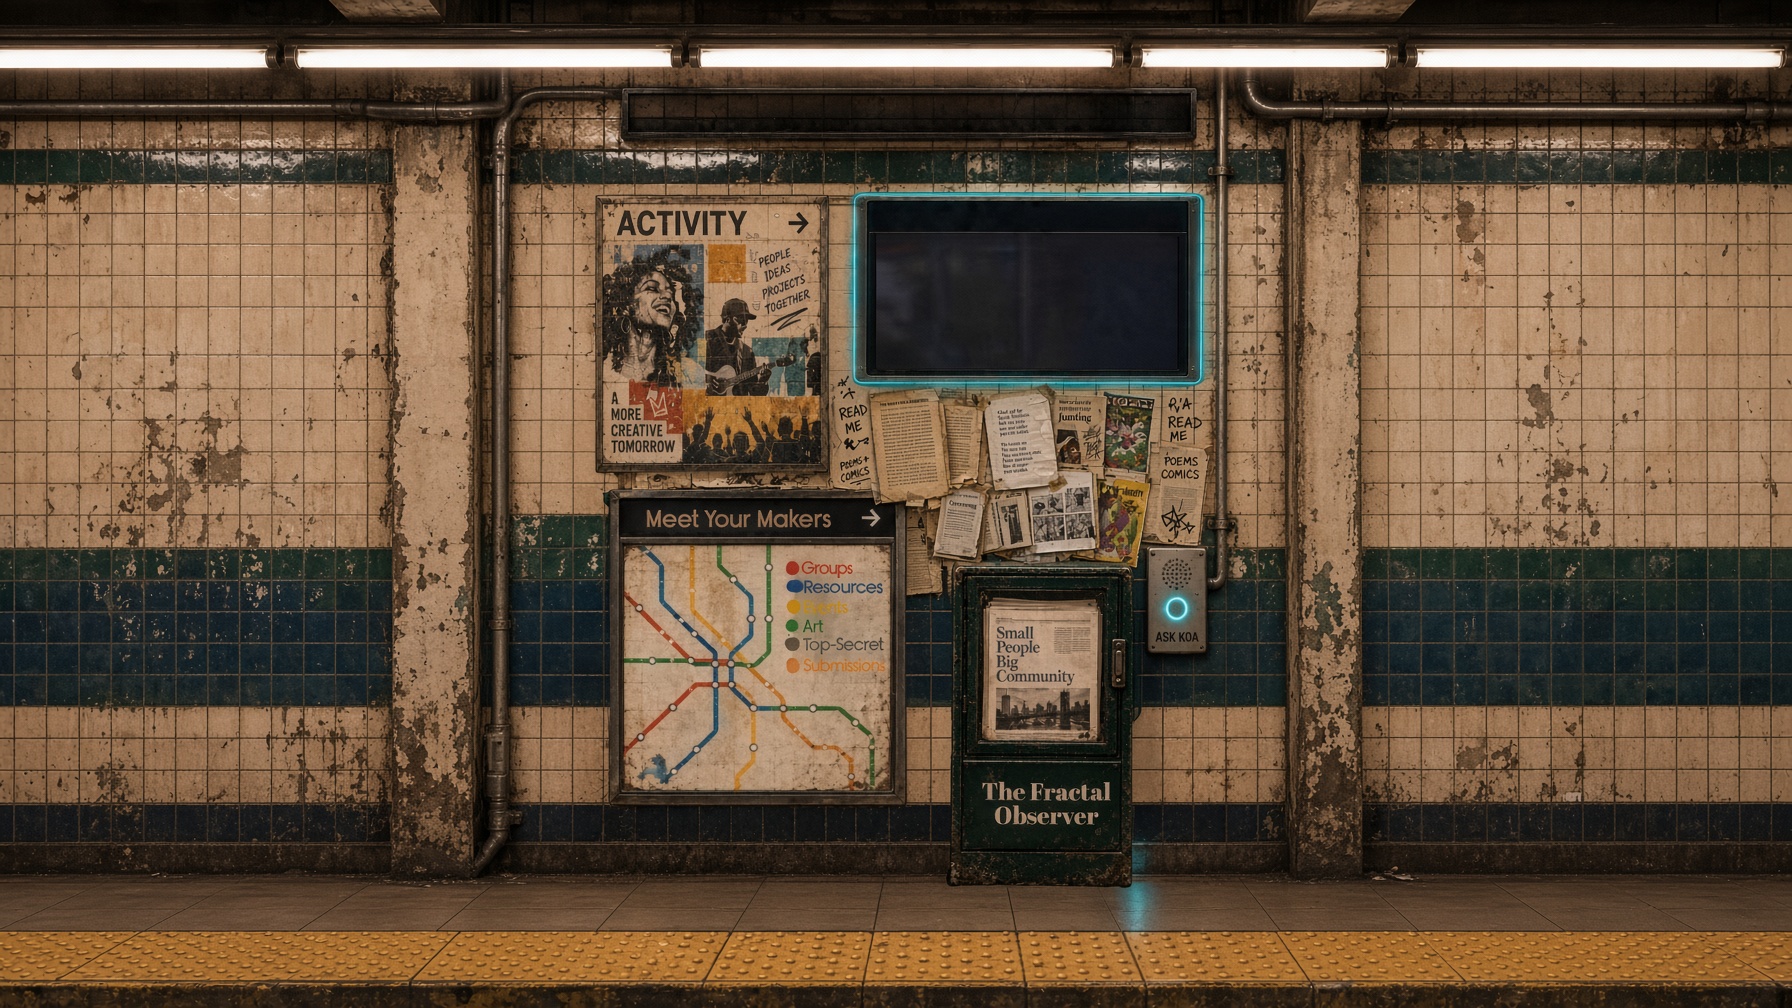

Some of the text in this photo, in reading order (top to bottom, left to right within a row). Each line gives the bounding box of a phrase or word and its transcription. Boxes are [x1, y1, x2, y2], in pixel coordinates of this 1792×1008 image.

[617, 210, 748, 236] ACTIVITY
[758, 248, 791, 268] PEOPLE
[764, 263, 791, 282] IDEAS
[762, 274, 806, 300] PROJECTS
[764, 289, 811, 314] TOGETHER
[611, 391, 619, 405] A
[611, 407, 641, 421] MORE
[839, 404, 868, 420] READ
[845, 420, 862, 434] ME
[1168, 415, 1203, 429] READ
[611, 423, 663, 438] CREATIVE
[1170, 430, 1187, 442] ME
[611, 439, 676, 454] TOMORROW
[1164, 456, 1198, 467] POEMS
[841, 466, 870, 483] COMICS
[1161, 468, 1200, 480] COMICS
[646, 509, 832, 528] Meet Your Makers
[801, 561, 853, 578] Groups
[804, 580, 884, 594] Resources
[803, 601, 848, 614] Events
[803, 620, 824, 633] Art
[996, 626, 1034, 639] Small
[1155, 631, 1199, 643] ASK KOA
[803, 637, 885, 654] Top-Secret
[996, 640, 1041, 657] People
[803, 658, 886, 672] Submissions
[996, 655, 1019, 671] Big
[996, 669, 1075, 686] Community
[982, 782, 1111, 801] The Fractal
[994, 804, 1100, 826] Observer
